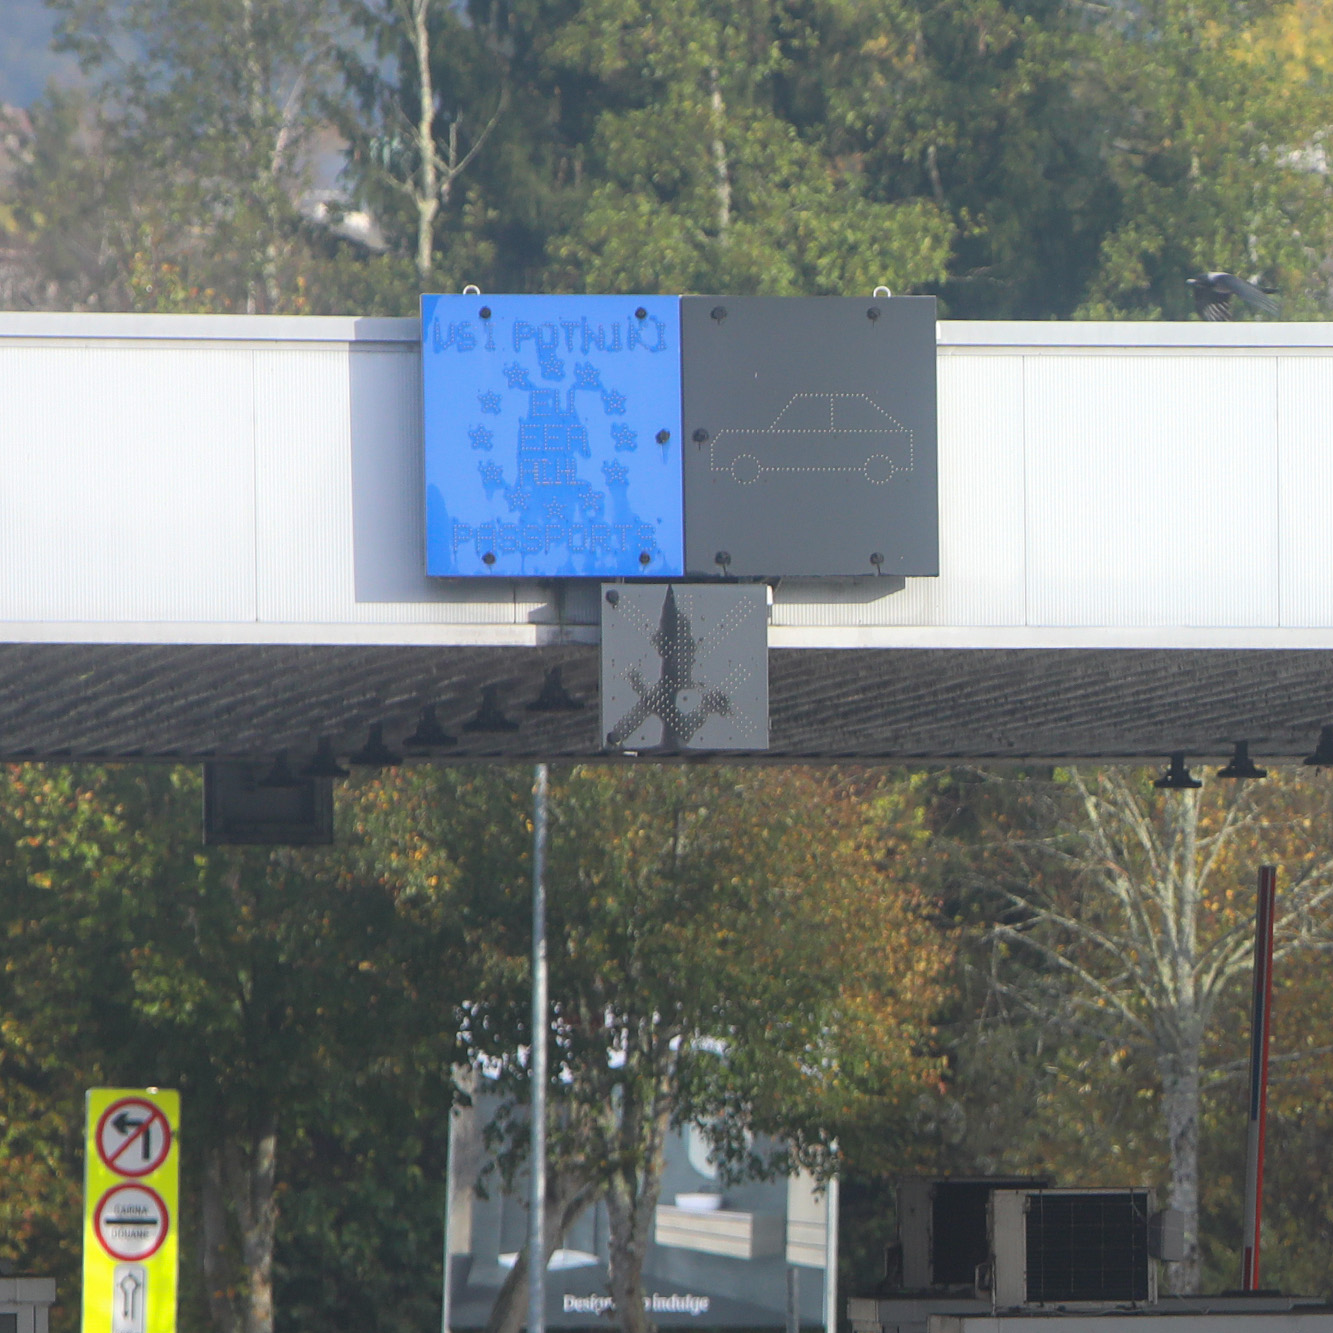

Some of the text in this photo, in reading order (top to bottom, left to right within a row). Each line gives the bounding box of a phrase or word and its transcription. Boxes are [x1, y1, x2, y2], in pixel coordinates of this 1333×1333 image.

[433, 321, 668, 351] VSI POTNIKI
[532, 389, 574, 416] EU
[520, 424, 587, 450] EEA
[453, 524, 656, 551] PASSPORTS
[652, 1292, 710, 1316] indulge
